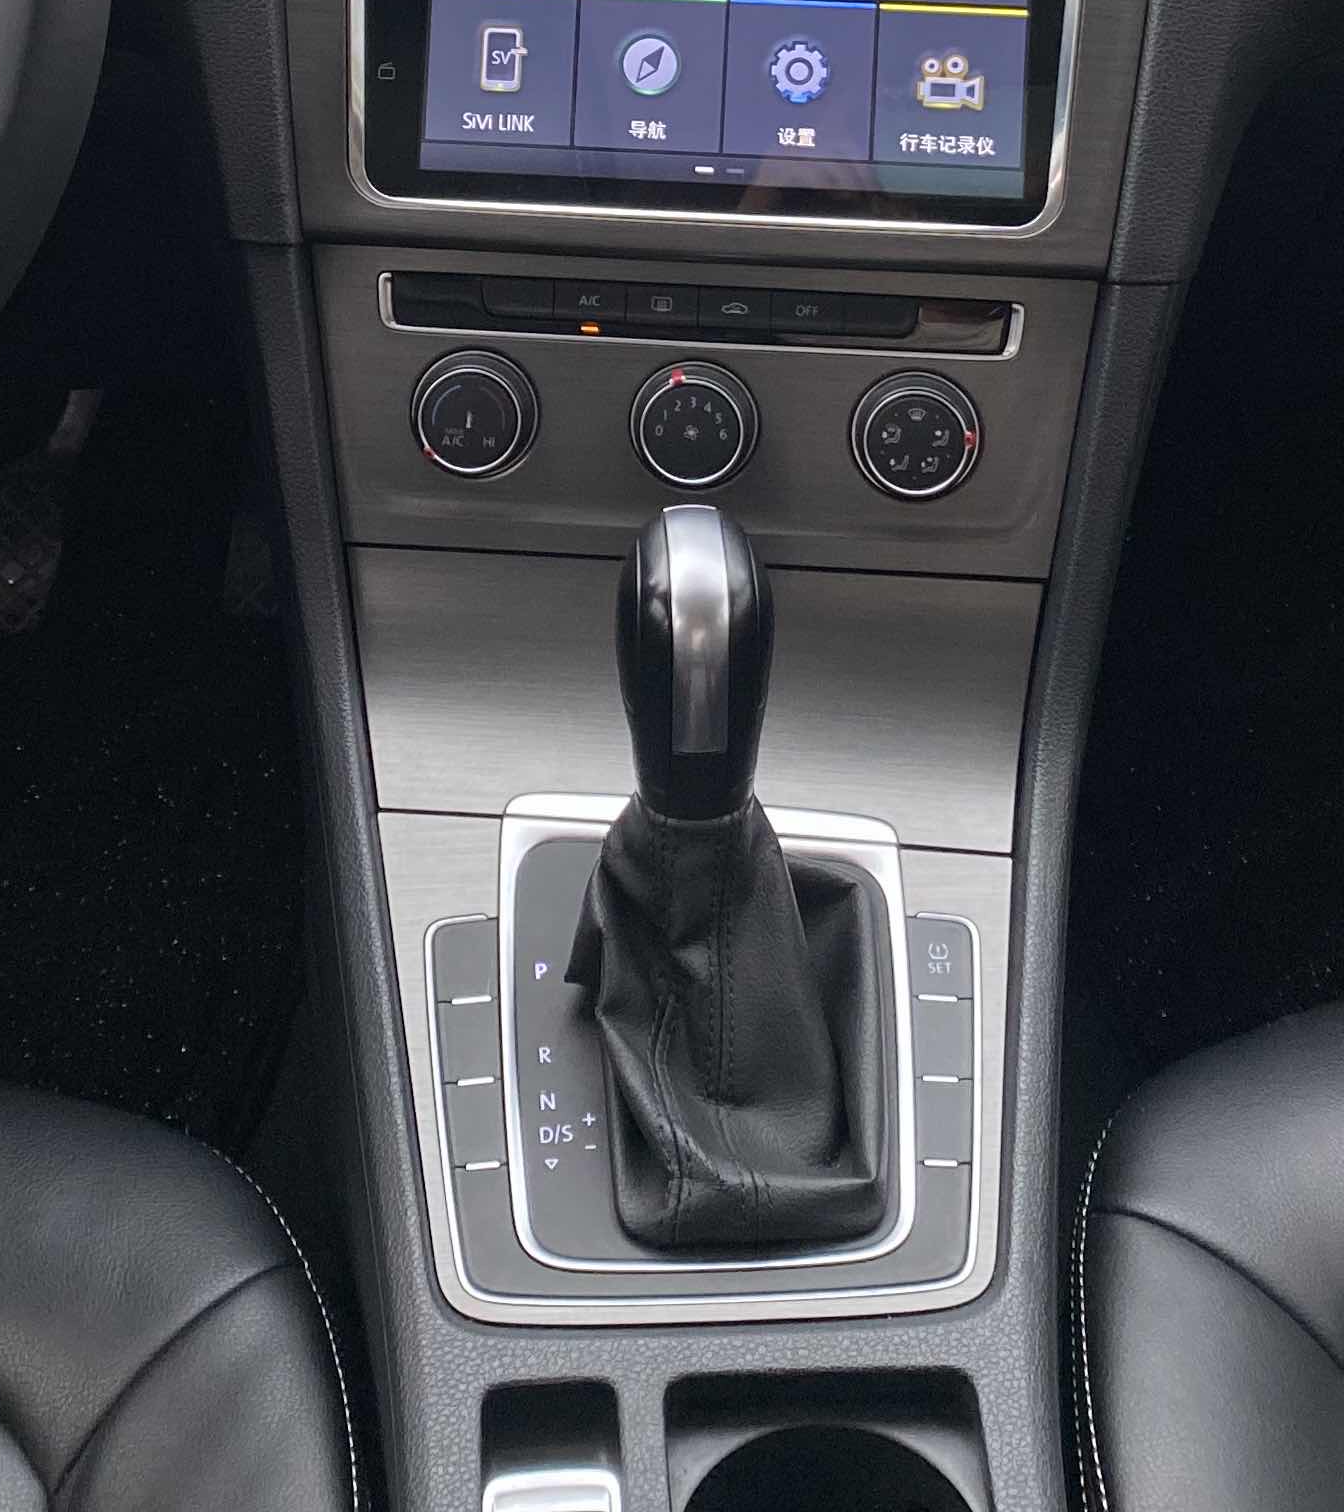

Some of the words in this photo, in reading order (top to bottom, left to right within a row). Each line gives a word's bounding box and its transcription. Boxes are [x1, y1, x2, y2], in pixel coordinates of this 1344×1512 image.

[461, 111, 494, 131] SiVi
[498, 113, 535, 133] LINK
[627, 119, 668, 141] 导航
[777, 127, 817, 148] 设置
[899, 132, 996, 156] 行车记录仪
[578, 295, 601, 307] A/C
[795, 303, 819, 317] OFF
[655, 424, 664, 437] 0
[674, 399, 682, 412] 2
[689, 396, 697, 408] 3
[703, 401, 712, 413] 4
[715, 412, 723, 424] 5
[719, 428, 728, 440] 6
[534, 962, 548, 980] P
[927, 961, 952, 974] SET
[538, 1046, 552, 1063] R
[539, 1092, 557, 1110] N
[538, 1123, 574, 1144] D/S
